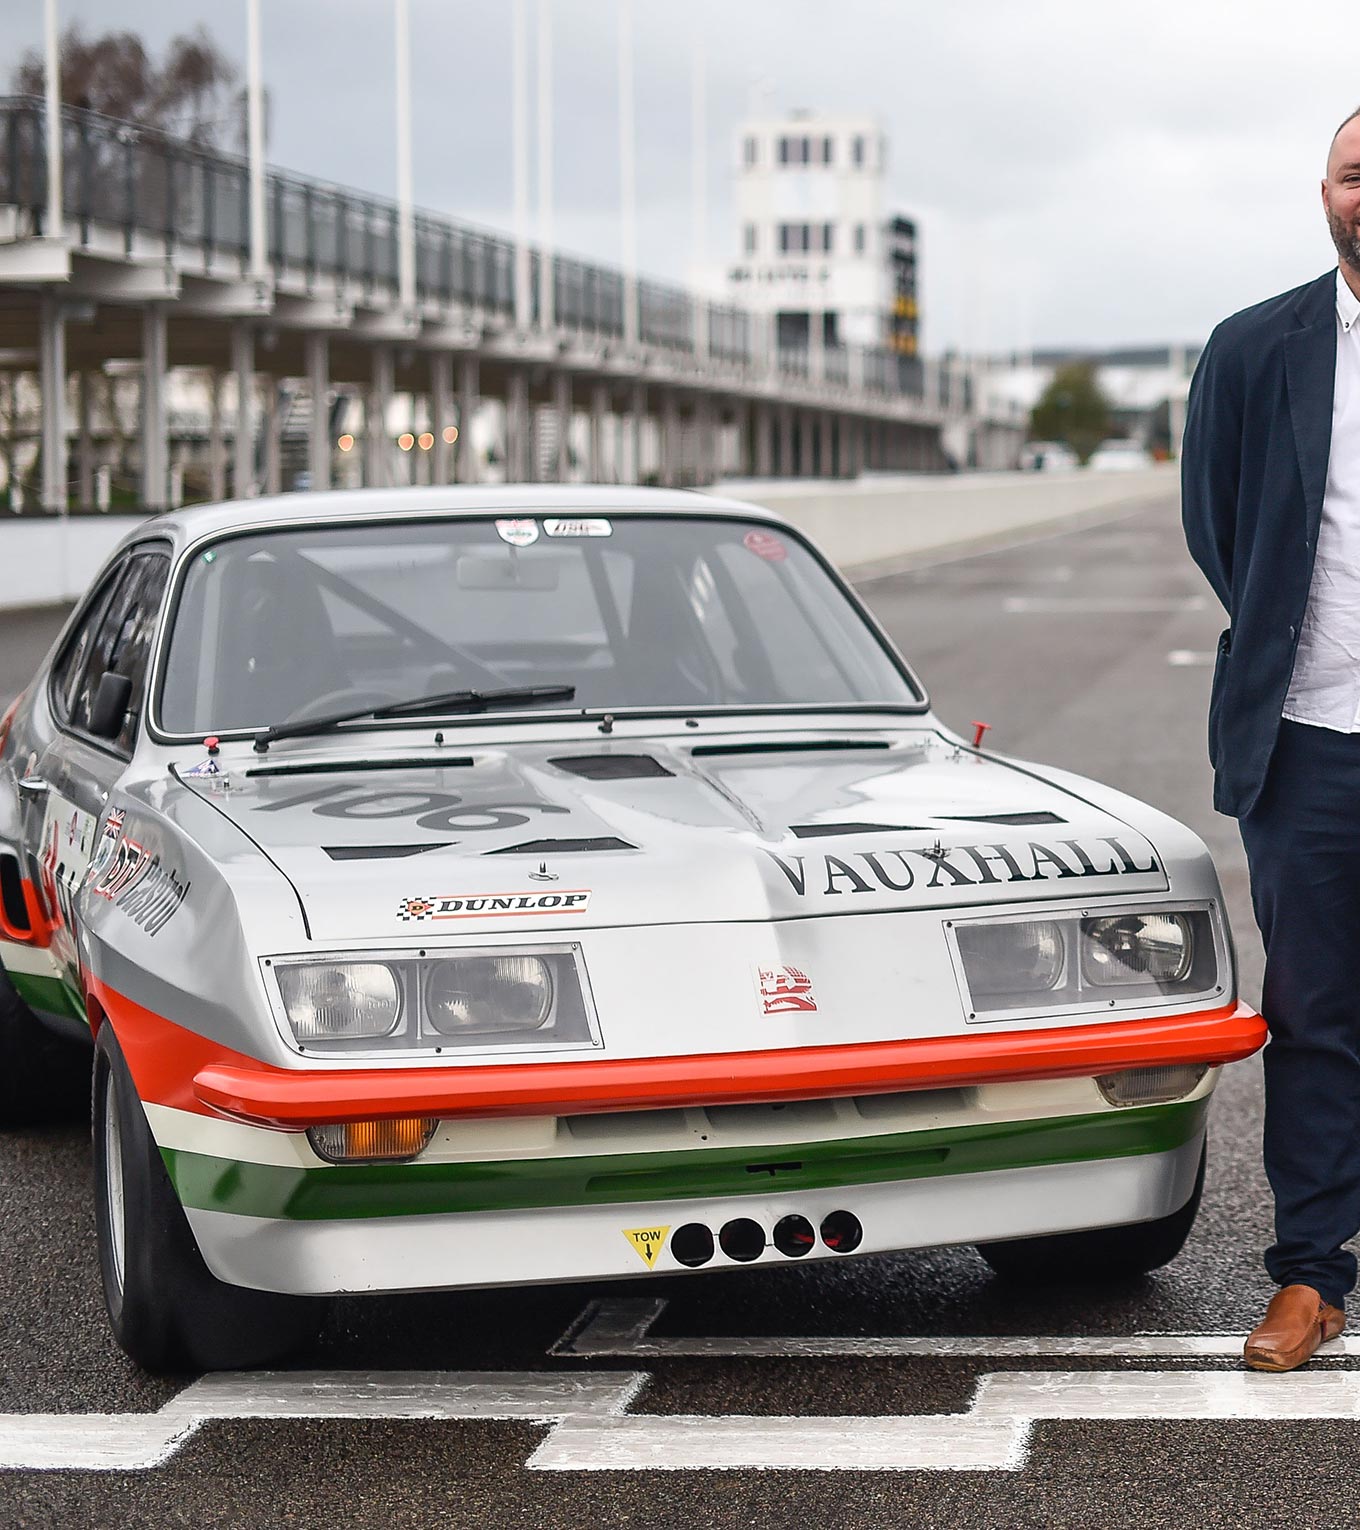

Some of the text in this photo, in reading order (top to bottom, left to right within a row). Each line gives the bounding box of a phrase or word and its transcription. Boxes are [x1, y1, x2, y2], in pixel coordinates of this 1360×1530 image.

[249, 784, 571, 831] 106
[756, 836, 1160, 896] VAUXHALL
[115, 855, 192, 938] Castrol
[437, 894, 588, 913] DUNLOP
[632, 1230, 661, 1243] TOW
